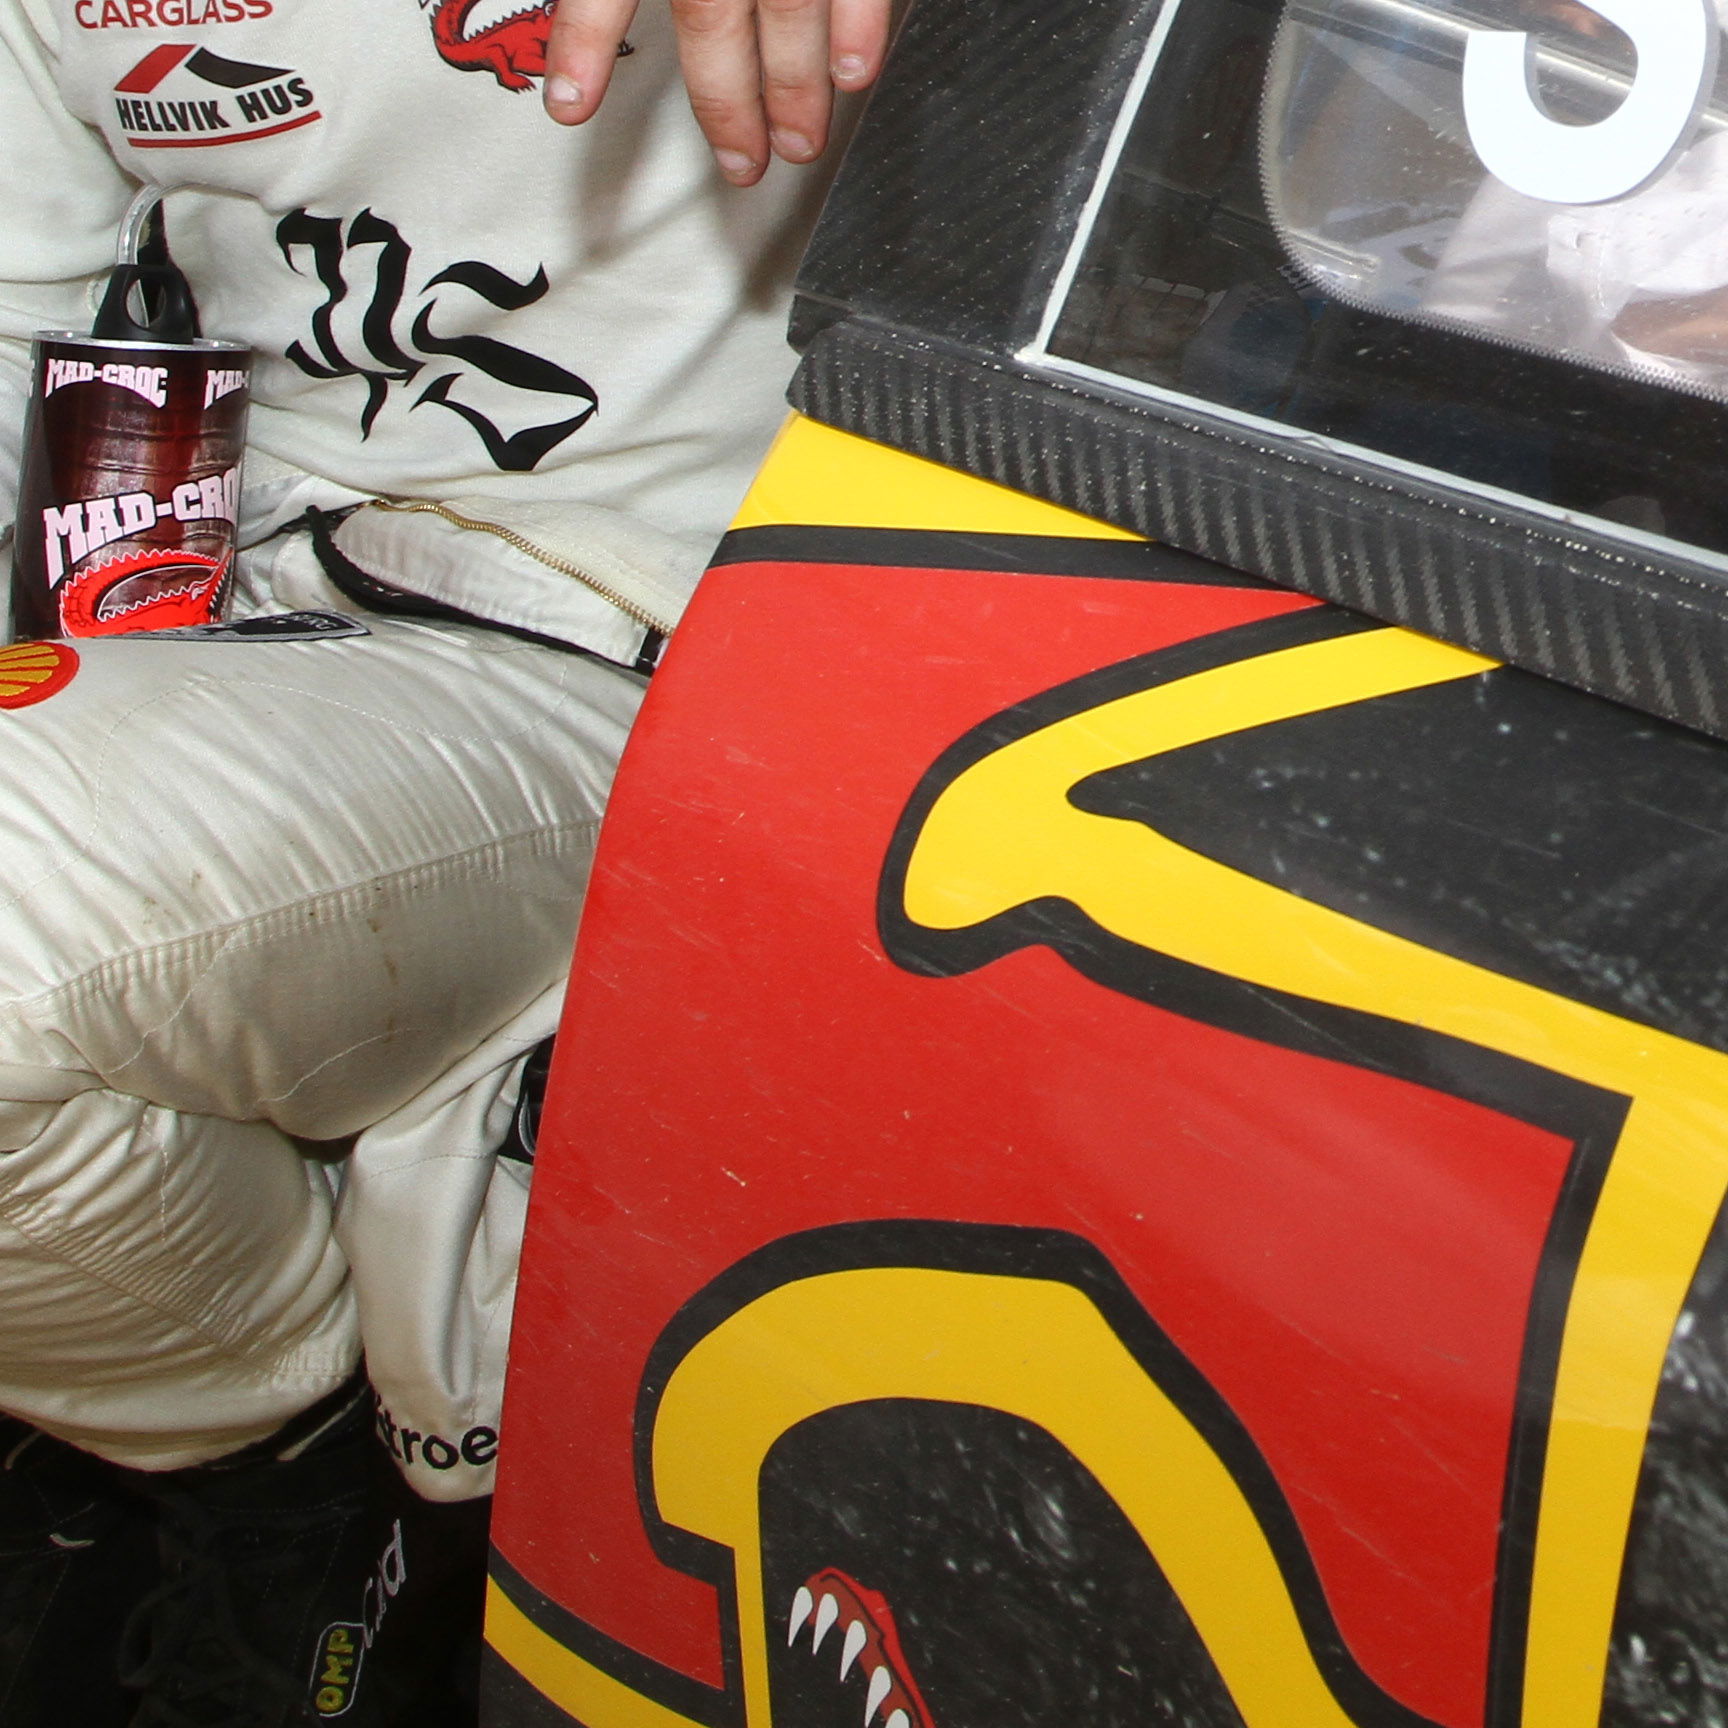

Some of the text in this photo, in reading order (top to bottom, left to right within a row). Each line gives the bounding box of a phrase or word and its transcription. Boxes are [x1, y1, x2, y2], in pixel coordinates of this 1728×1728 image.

[115, 76, 314, 133] HELLVIK HUS
[45, 358, 168, 409] MAD-CROC
[315, 1628, 354, 1712] OMP
